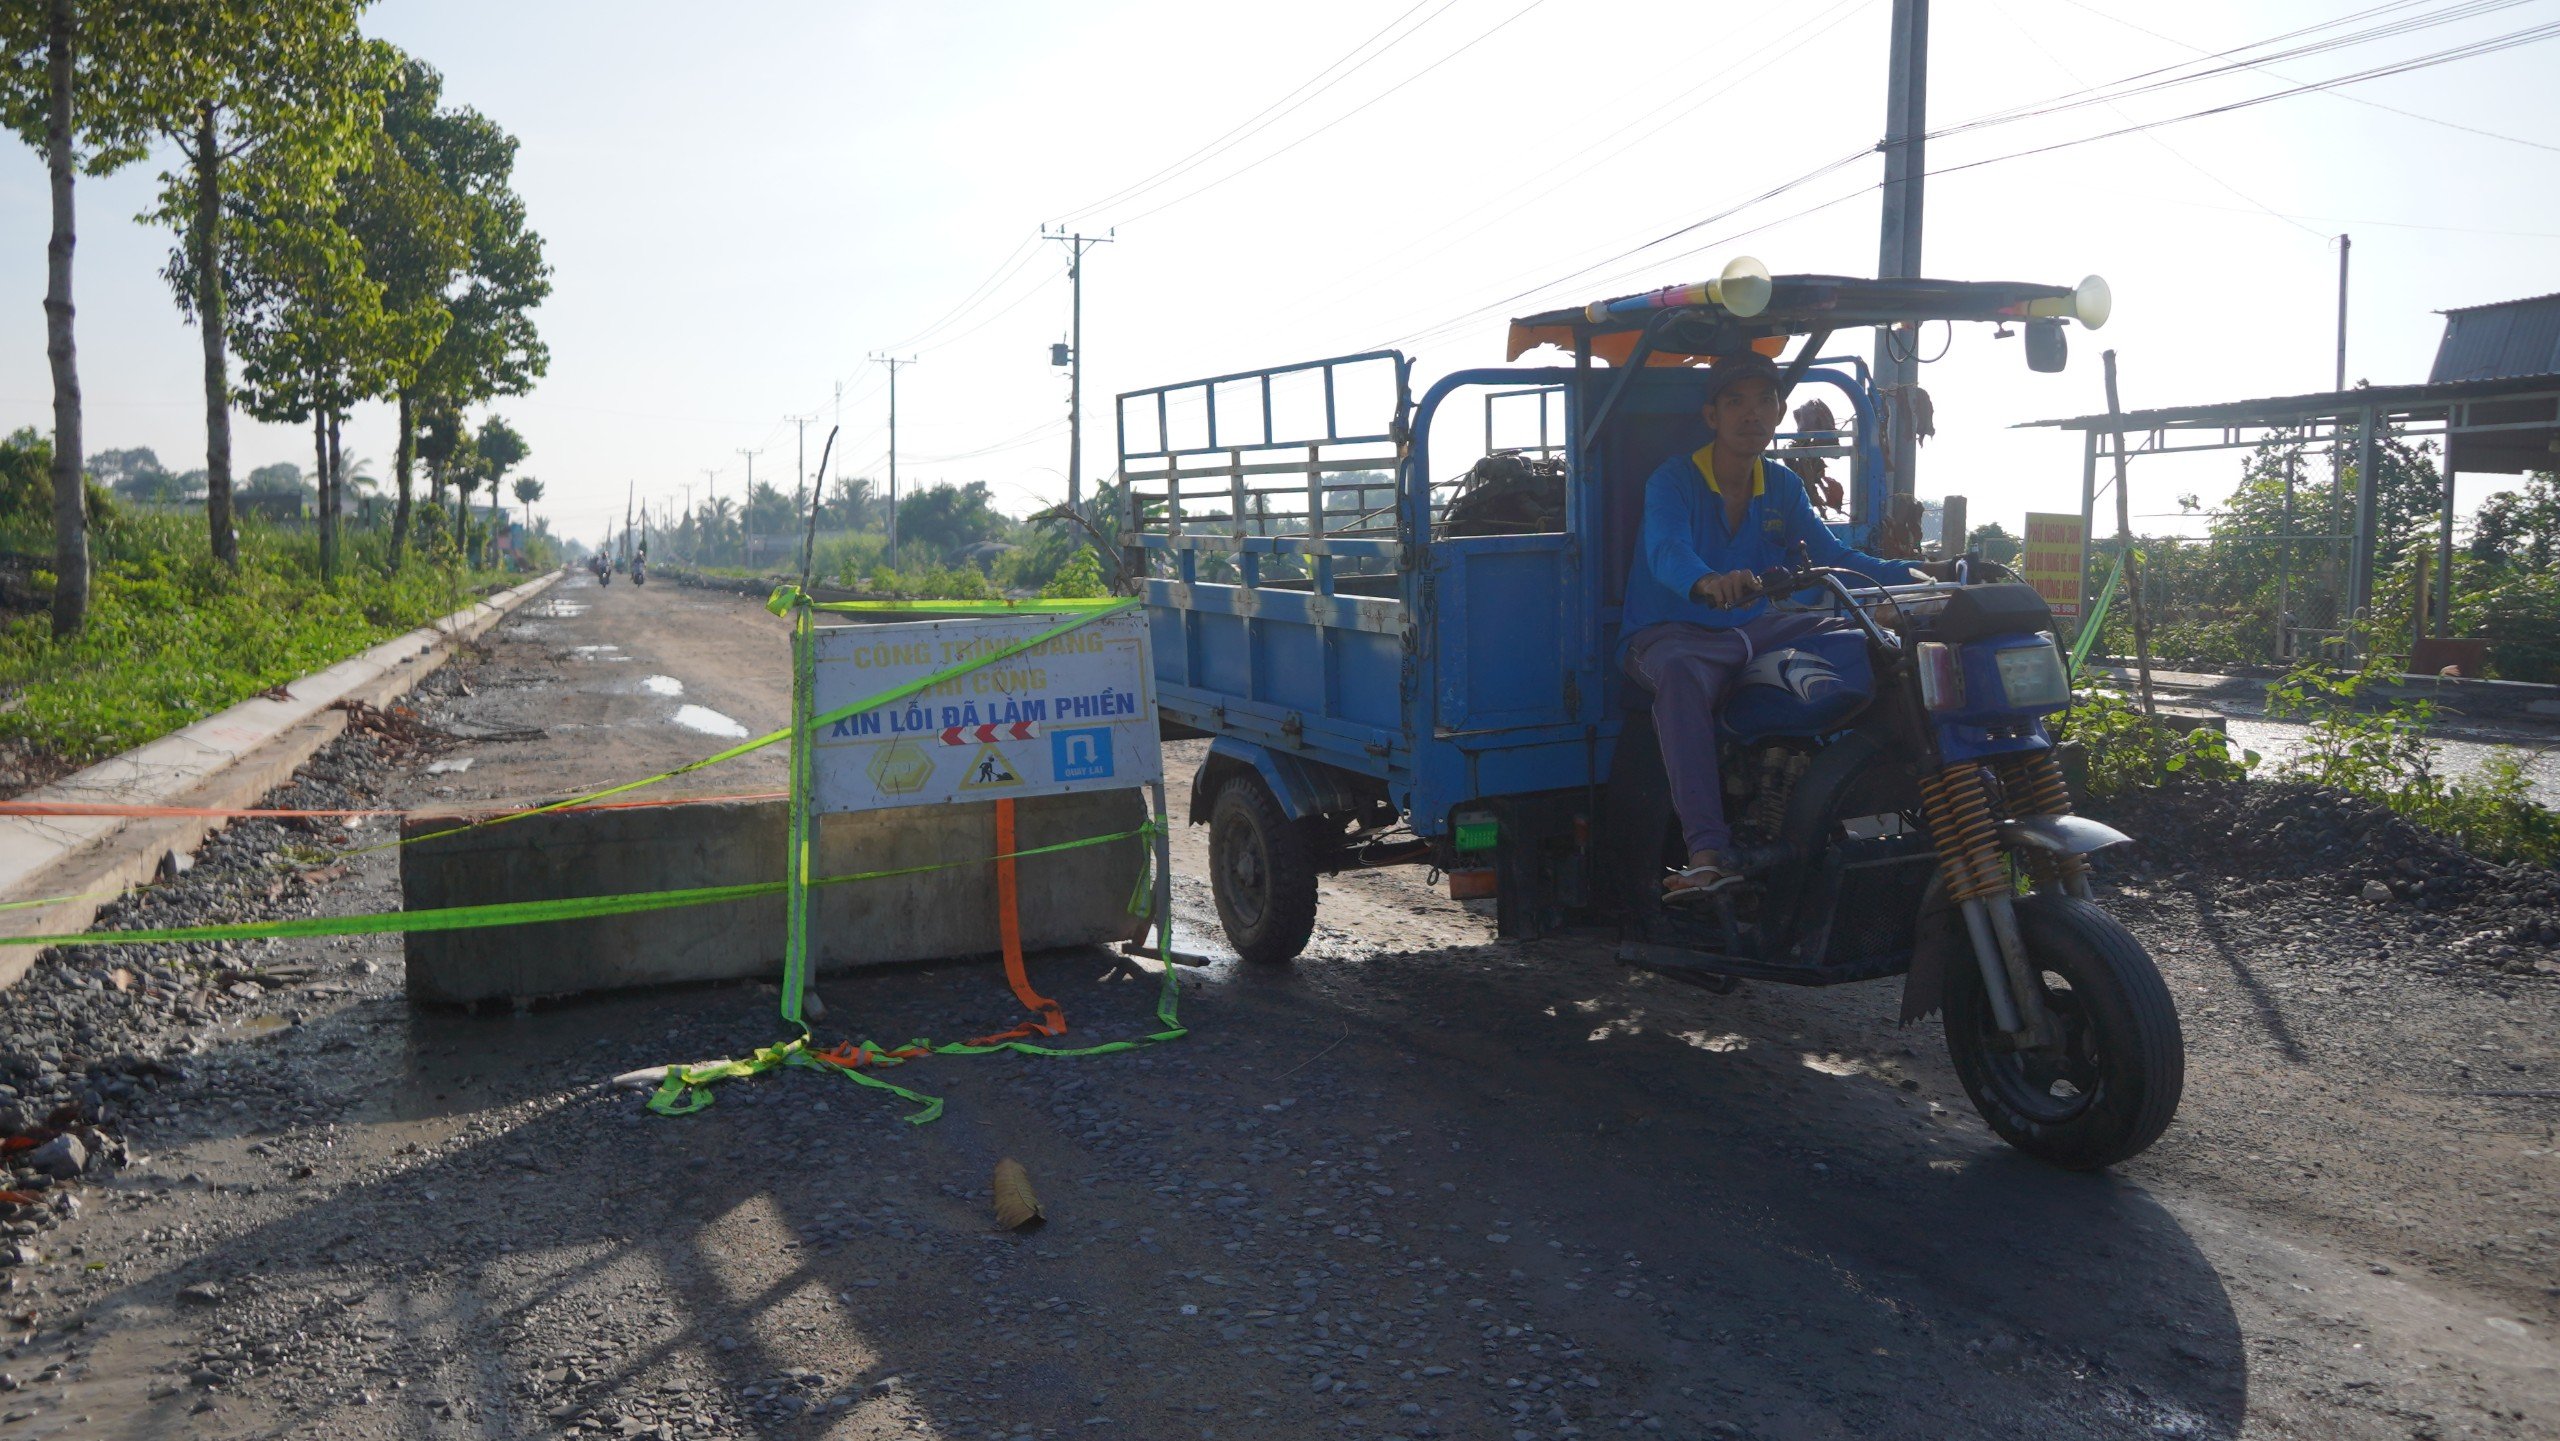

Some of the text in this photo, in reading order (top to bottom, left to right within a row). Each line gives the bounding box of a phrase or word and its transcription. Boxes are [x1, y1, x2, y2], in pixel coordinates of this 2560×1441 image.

[854, 641, 931, 669] CÔNG
[972, 667, 1047, 694] CÔNG
[831, 687, 1136, 738] XIN LỖI ĐÃ LÀM PHIỀN
